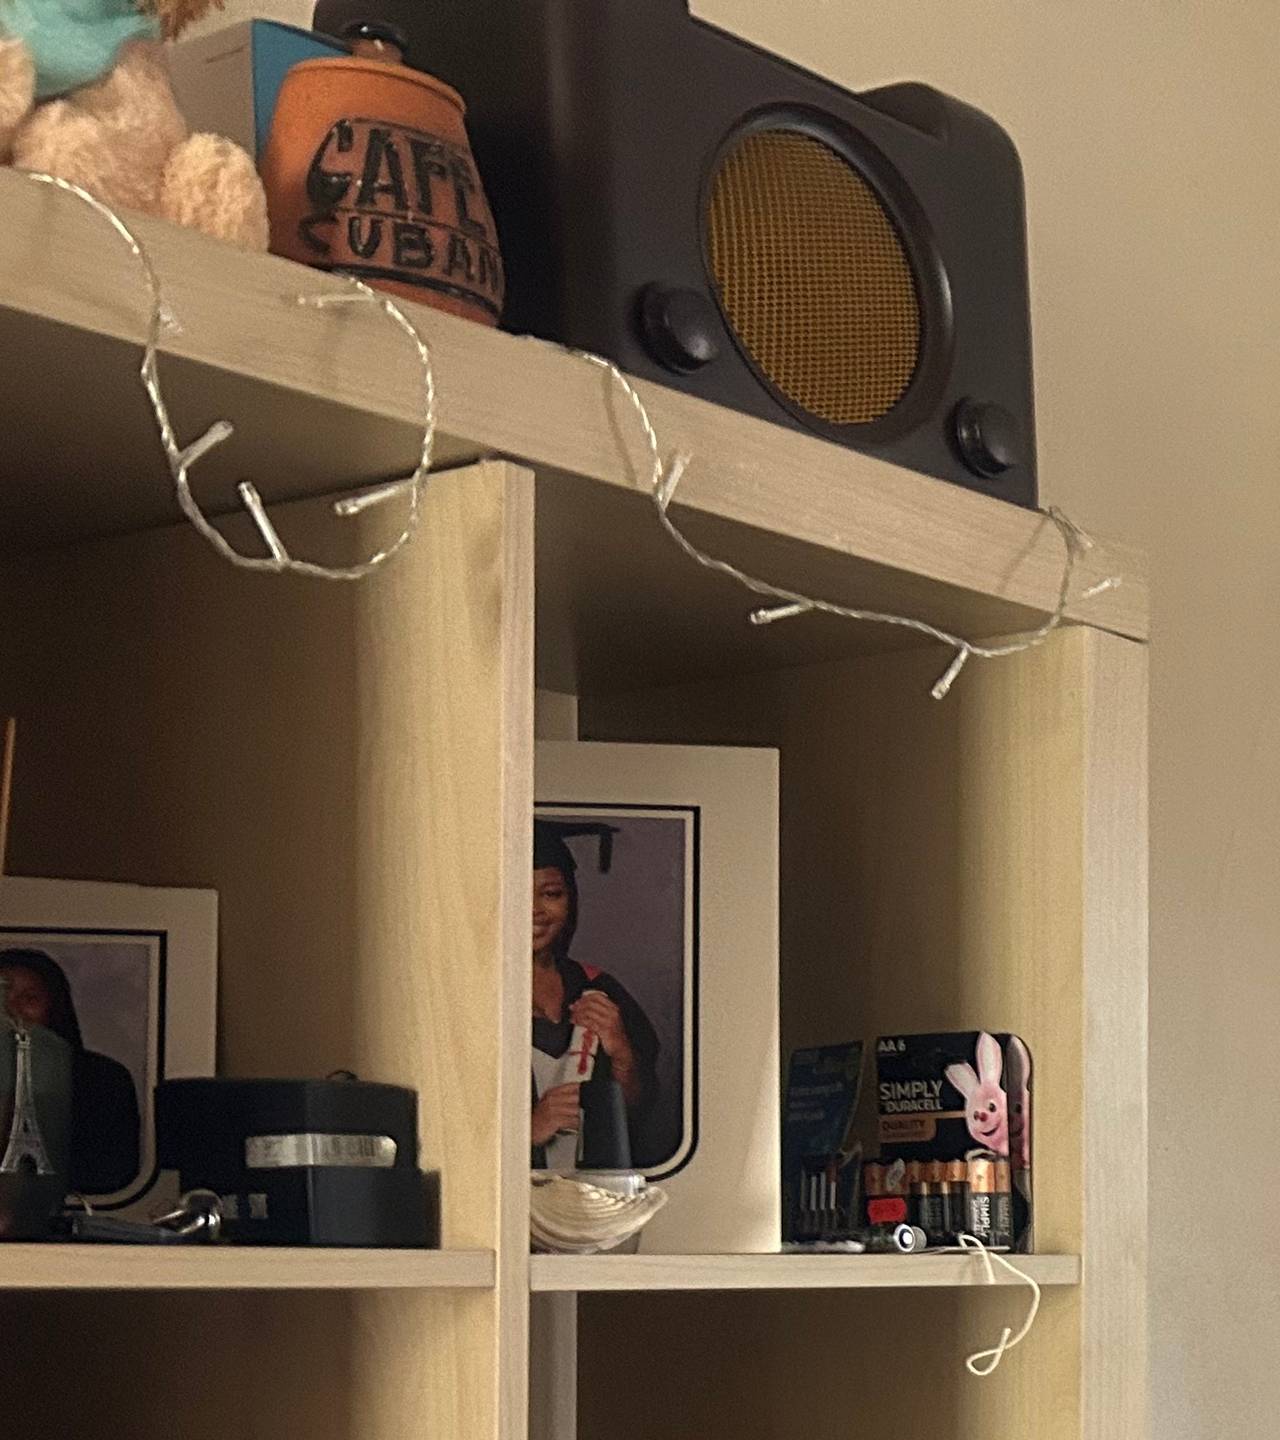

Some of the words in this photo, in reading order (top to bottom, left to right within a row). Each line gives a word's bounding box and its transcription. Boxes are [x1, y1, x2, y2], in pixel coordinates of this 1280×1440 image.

[879, 1079, 943, 1100] SIMPLY
[886, 1098, 944, 1113] DURACELL
[980, 1196, 990, 1237] SIMPLY
